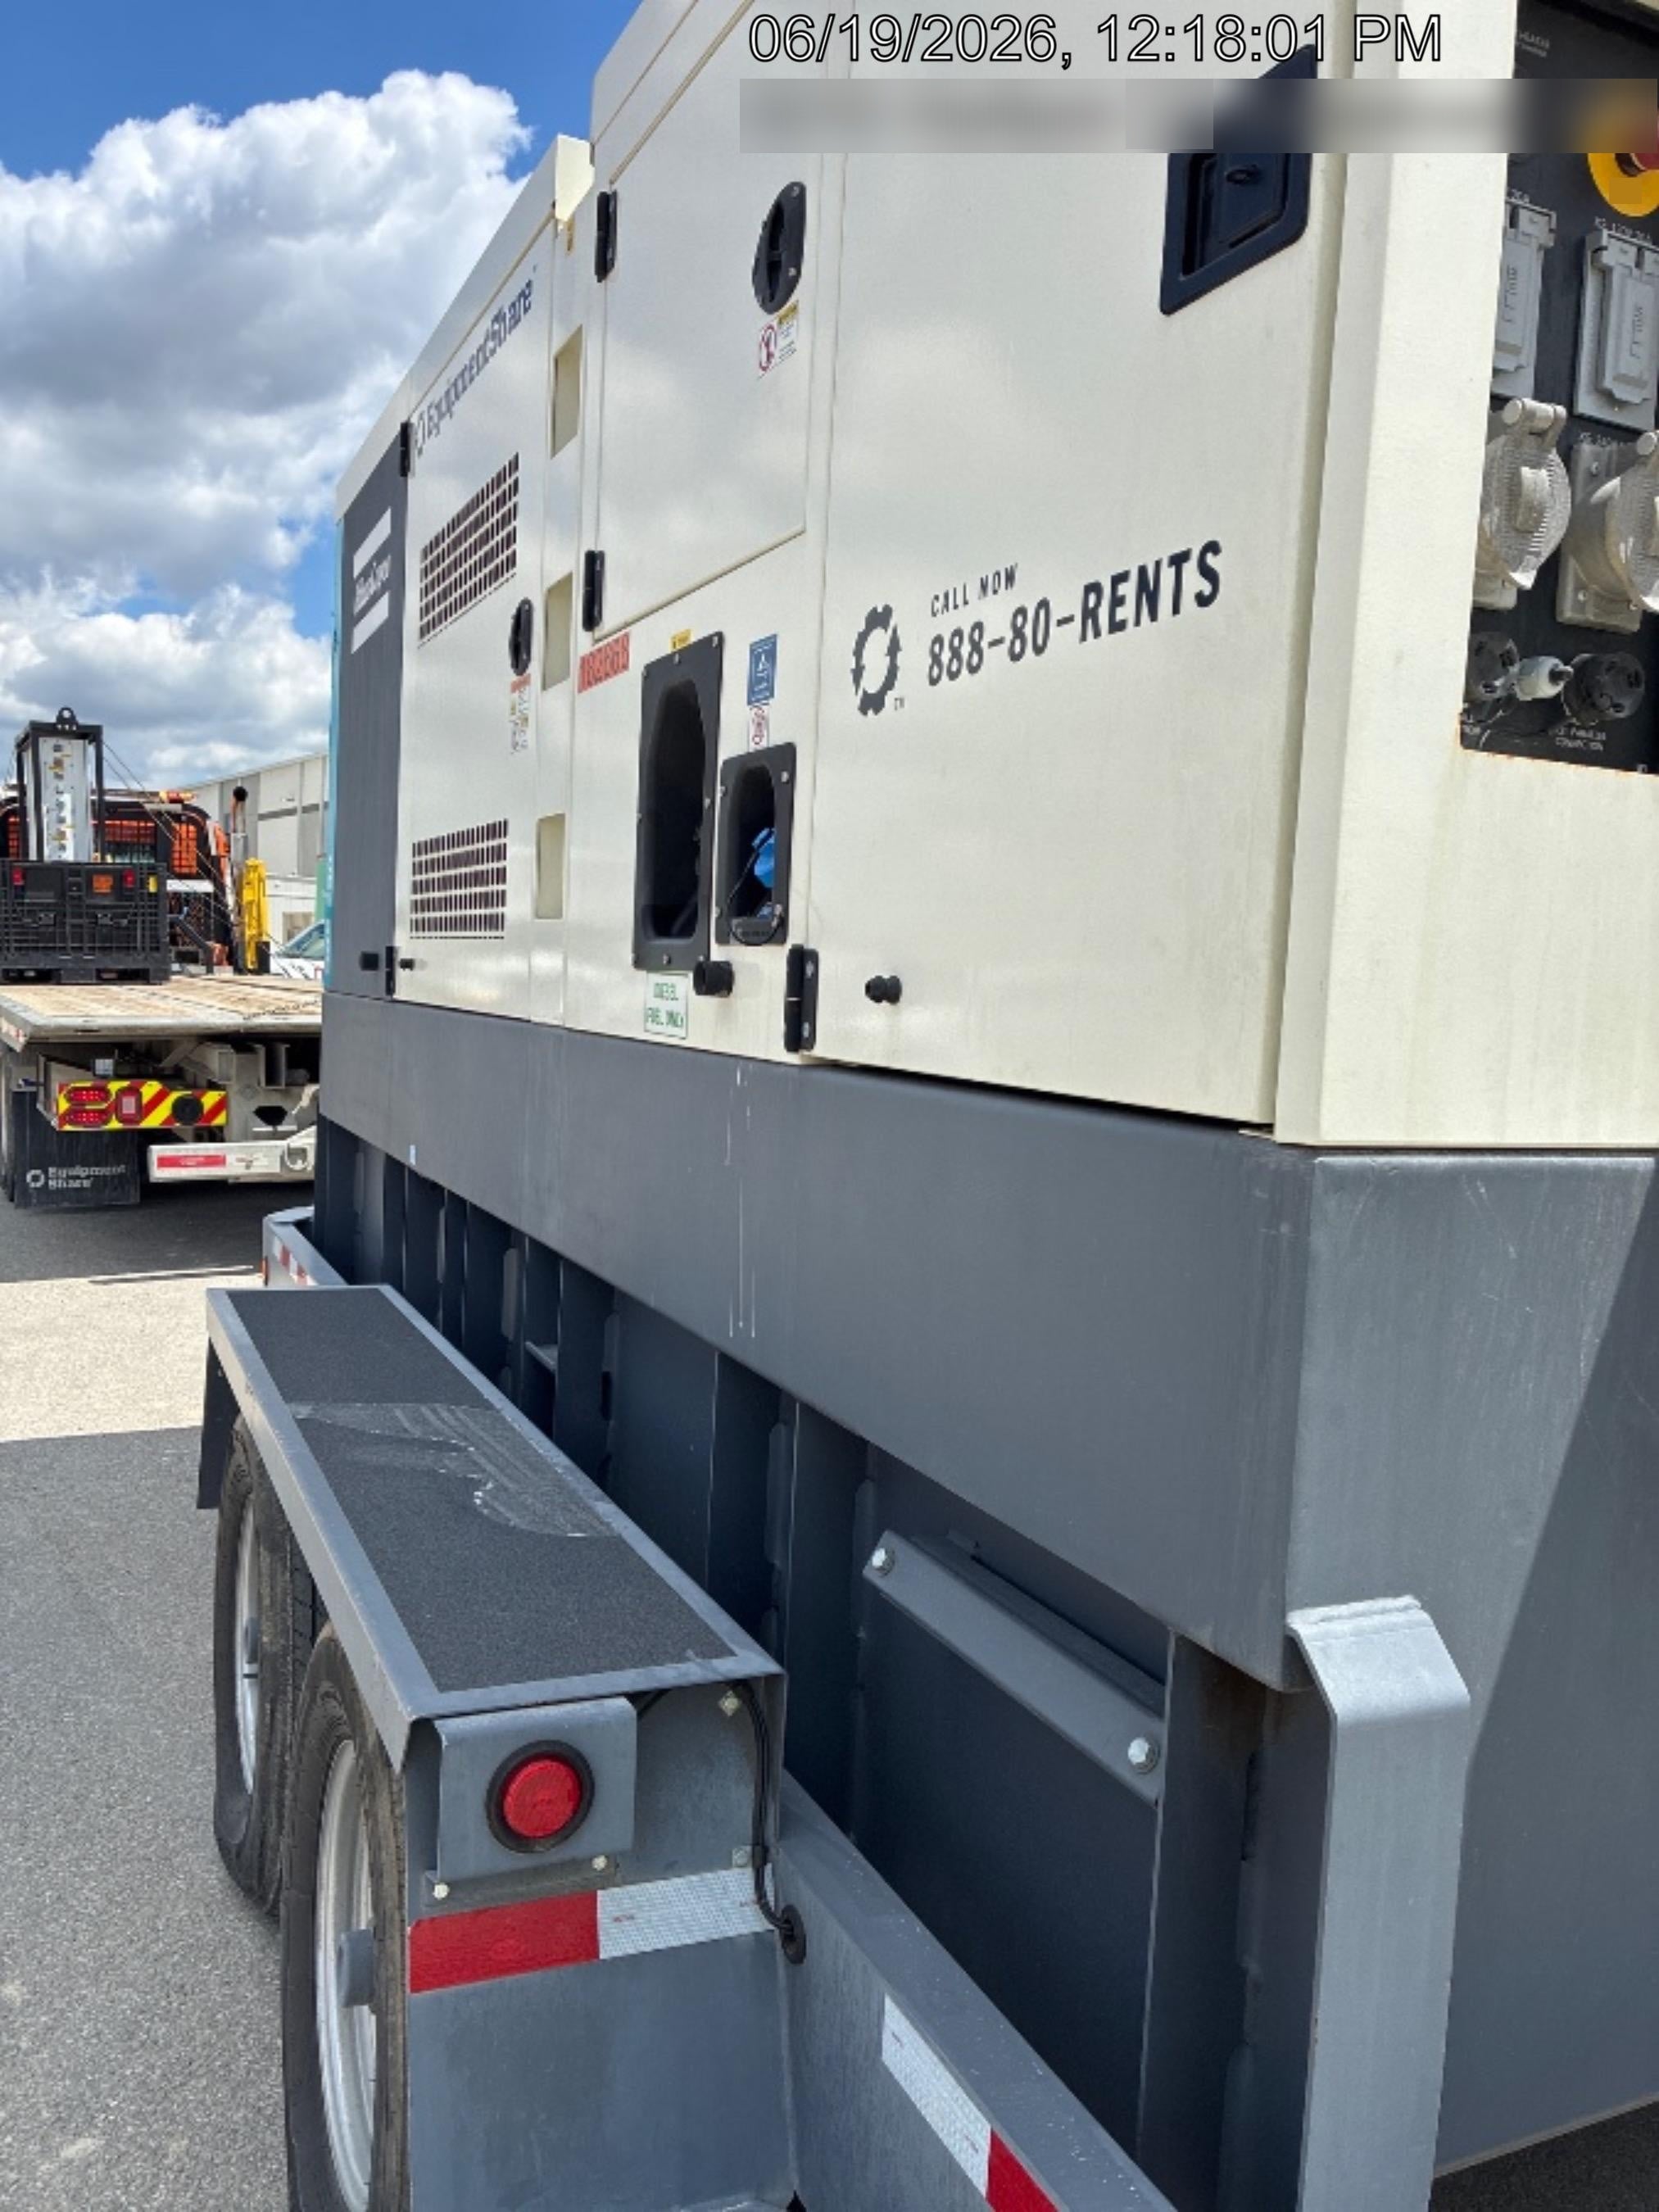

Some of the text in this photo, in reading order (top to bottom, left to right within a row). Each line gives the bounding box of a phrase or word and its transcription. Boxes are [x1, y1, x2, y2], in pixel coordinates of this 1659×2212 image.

[927, 539, 1223, 687] 888-80-RENTS
[931, 563, 1018, 618] CALL NOW
